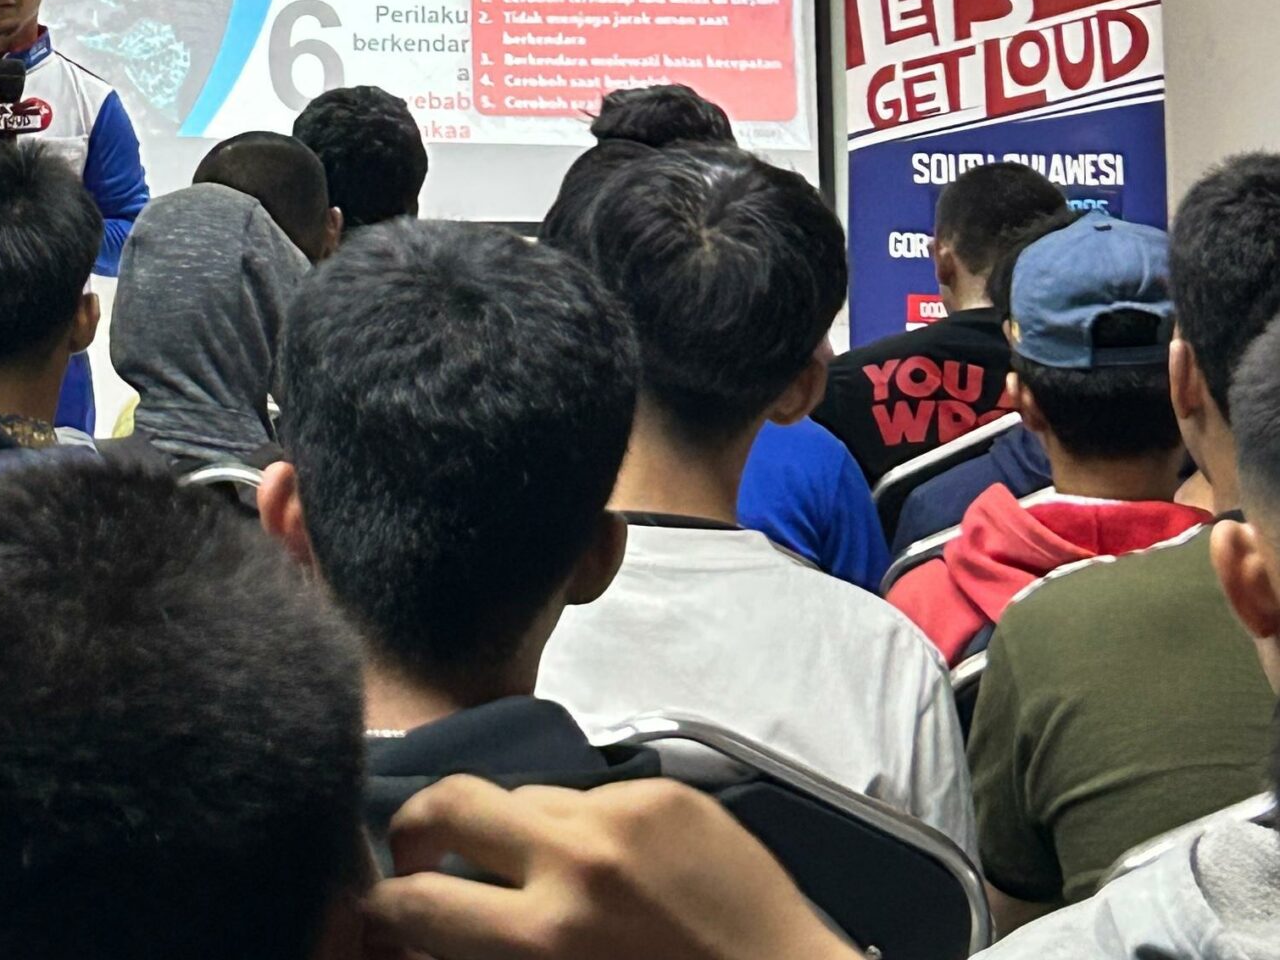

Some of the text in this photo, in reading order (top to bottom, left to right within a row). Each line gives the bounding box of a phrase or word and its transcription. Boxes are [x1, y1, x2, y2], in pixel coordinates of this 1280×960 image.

[375, 5, 469, 24] Perilaku
[352, 32, 470, 53] berkendar
[456, 68, 470, 81] a
[866, 9, 1149, 129] GET LOUD
[409, 91, 470, 111] ebab
[888, 231, 930, 258] GOR
[862, 355, 985, 403] YOU
